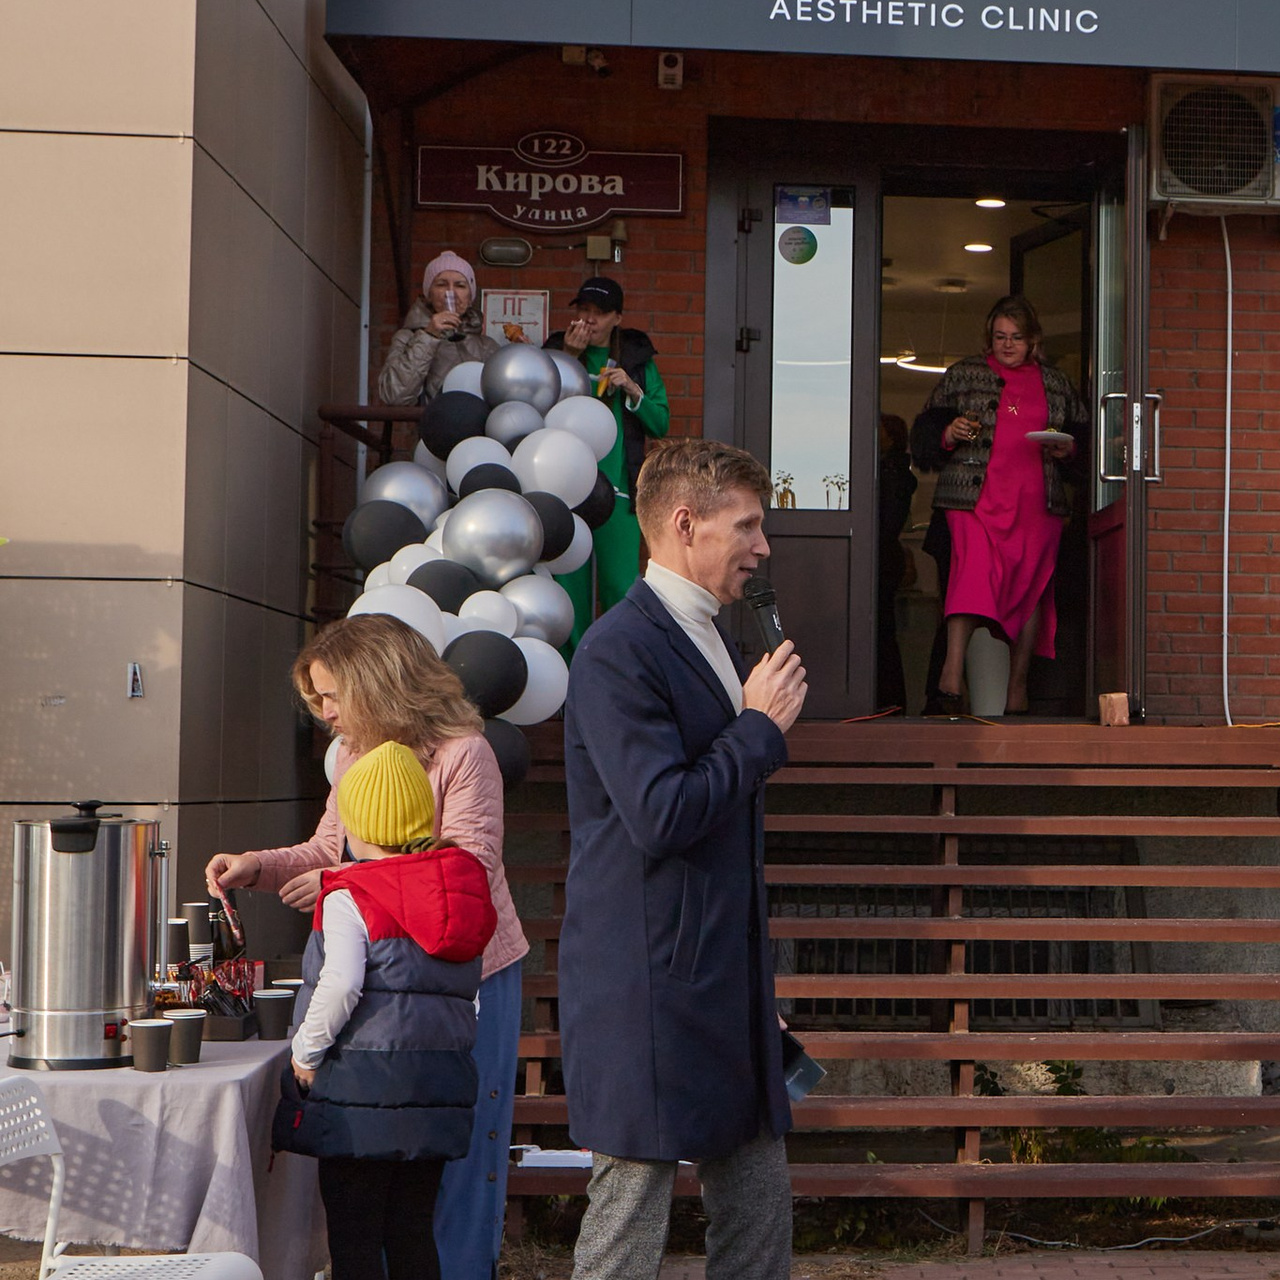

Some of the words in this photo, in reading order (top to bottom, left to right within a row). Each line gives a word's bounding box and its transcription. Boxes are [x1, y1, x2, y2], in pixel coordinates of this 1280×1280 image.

[981, 5, 1099, 33] CLINIC
[533, 138, 572, 154] 122
[476, 165, 625, 201] Кирова
[513, 204, 588, 222] улица
[503, 297, 527, 316] ПГ
